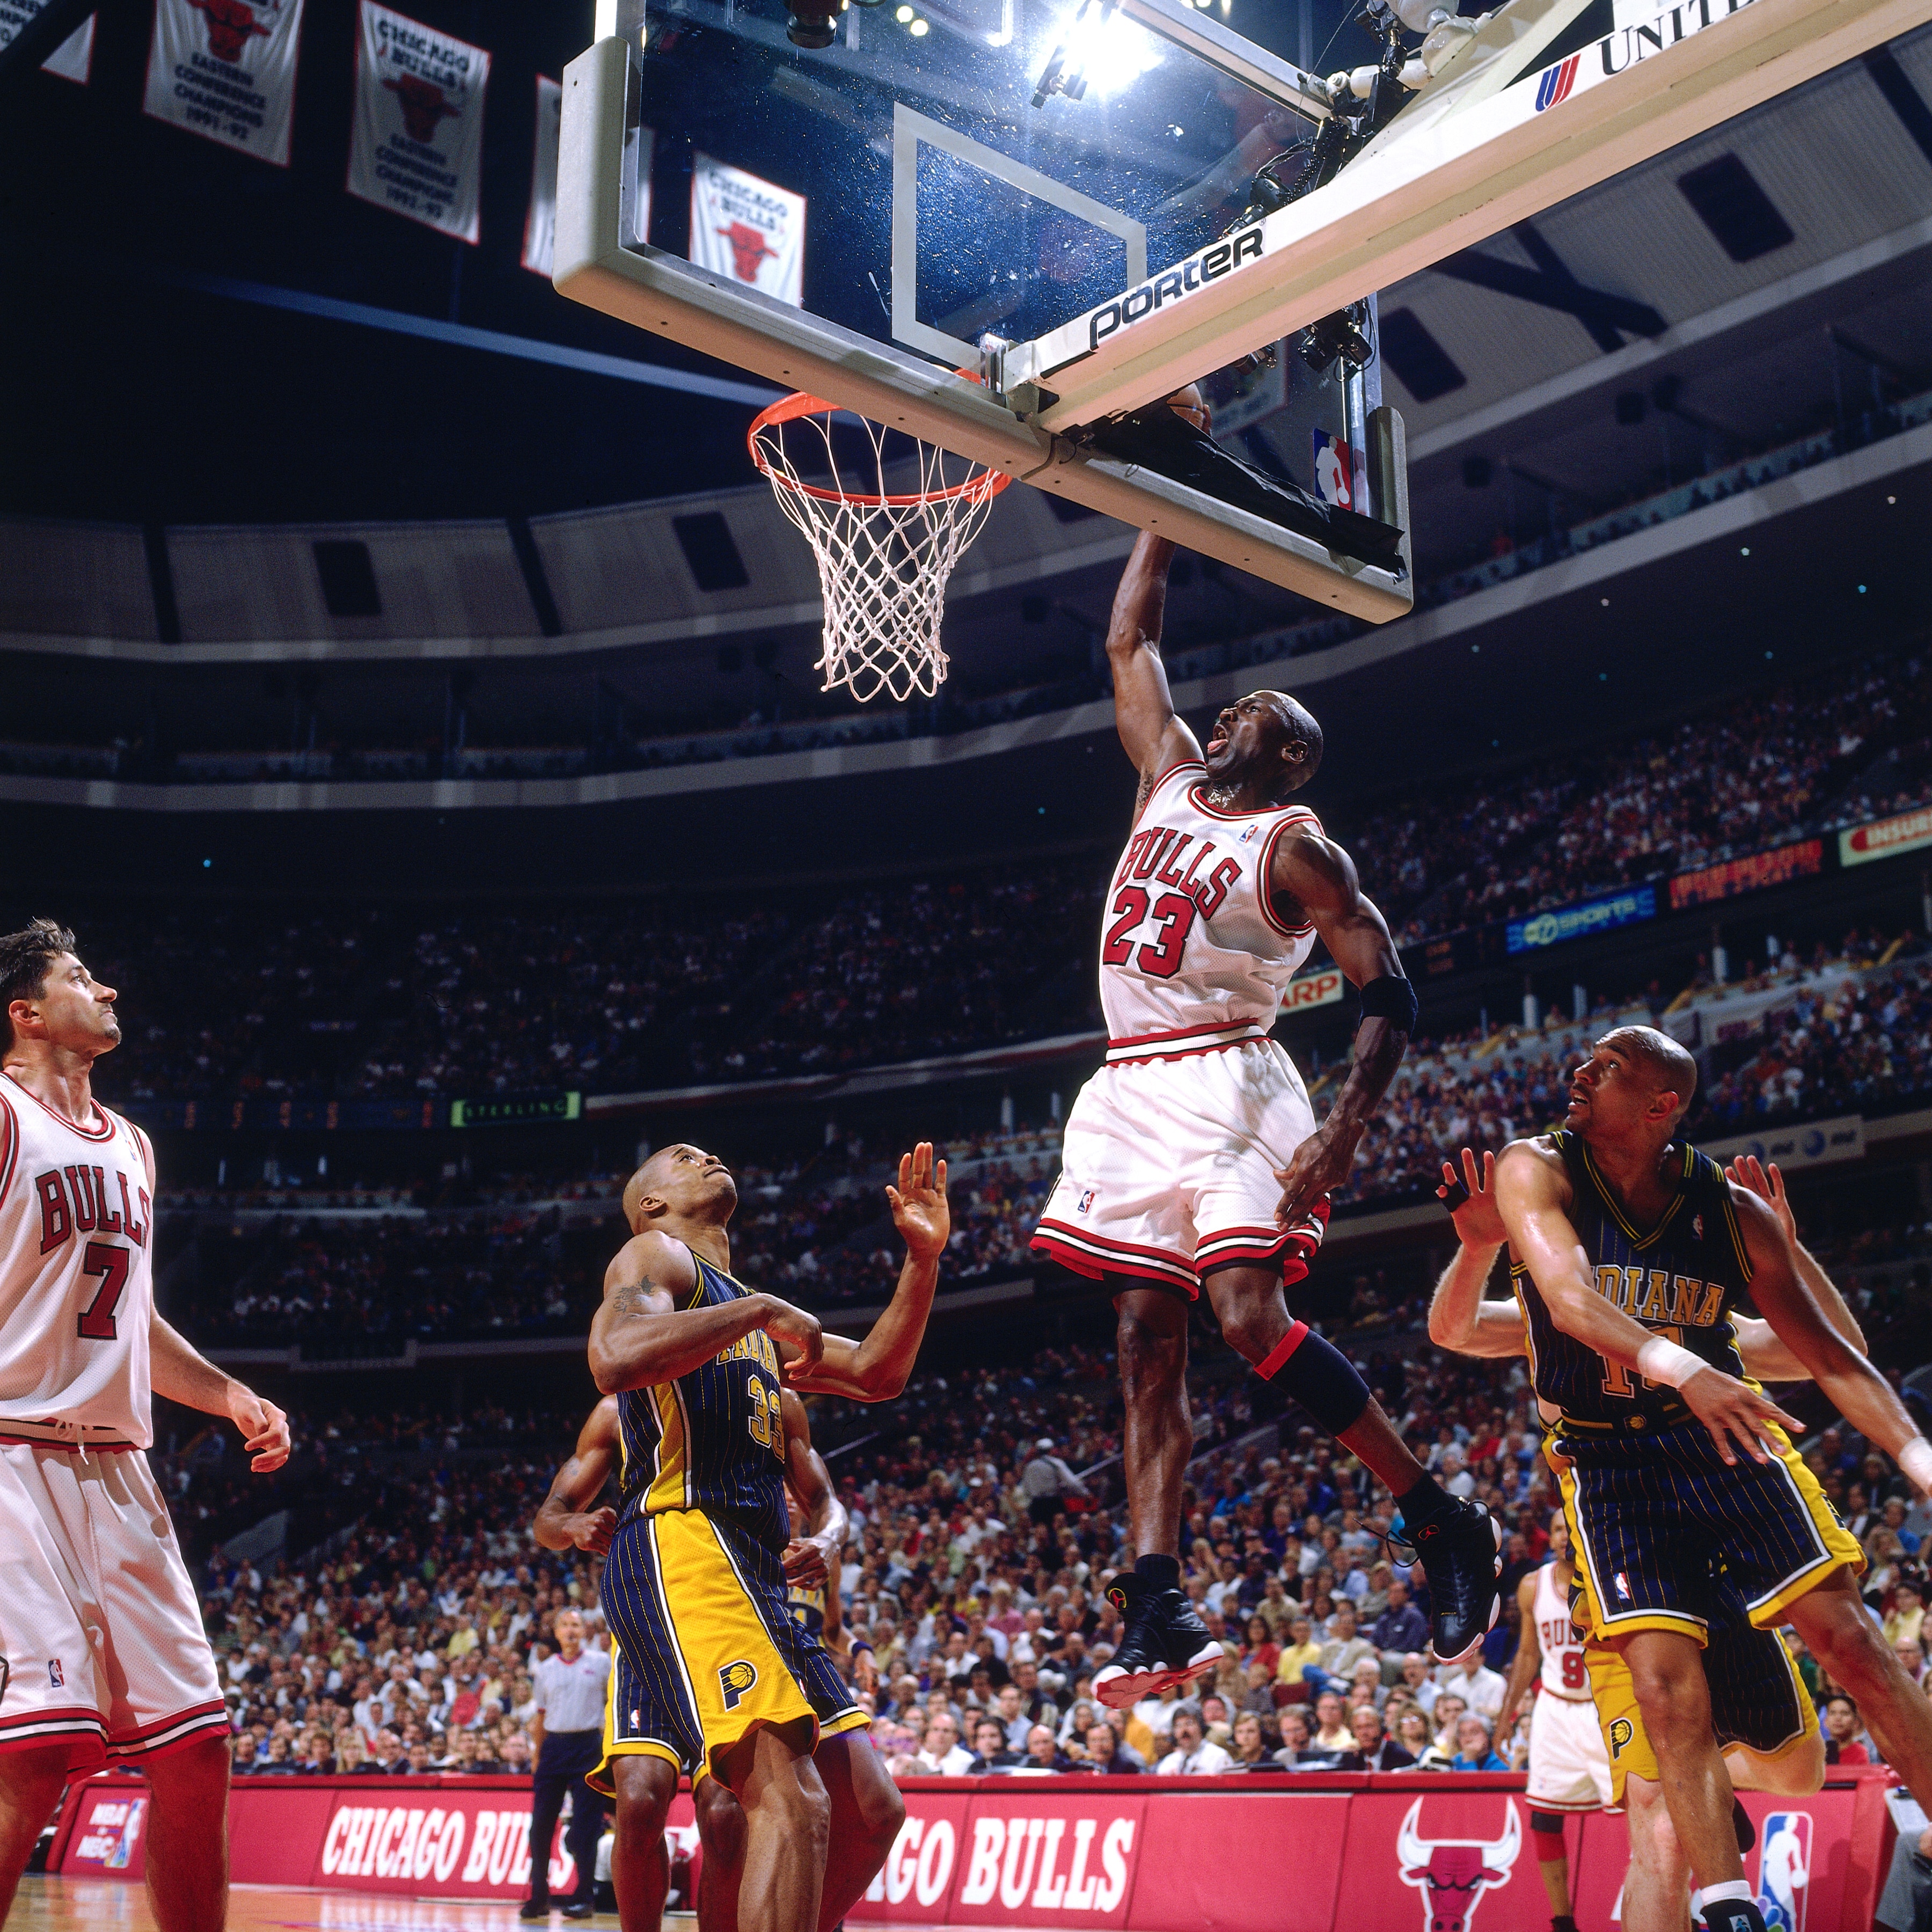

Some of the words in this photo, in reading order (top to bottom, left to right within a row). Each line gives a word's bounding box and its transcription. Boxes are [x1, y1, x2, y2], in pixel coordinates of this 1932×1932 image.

[1867, 813, 1932, 846] INSUR
[1113, 827, 1242, 920] BULLS
[1103, 885, 1197, 979] 23
[1281, 975, 1338, 1009] RP
[77, 1241, 130, 1340] 7
[1591, 1264, 1724, 1327] DIANA
[748, 1374, 785, 1464] 33
[1563, 1651, 1585, 1689] 9
[322, 1805, 466, 1883] CHICAGO
[462, 1811, 575, 1889] BULS
[960, 1817, 1136, 1913] BULLS
